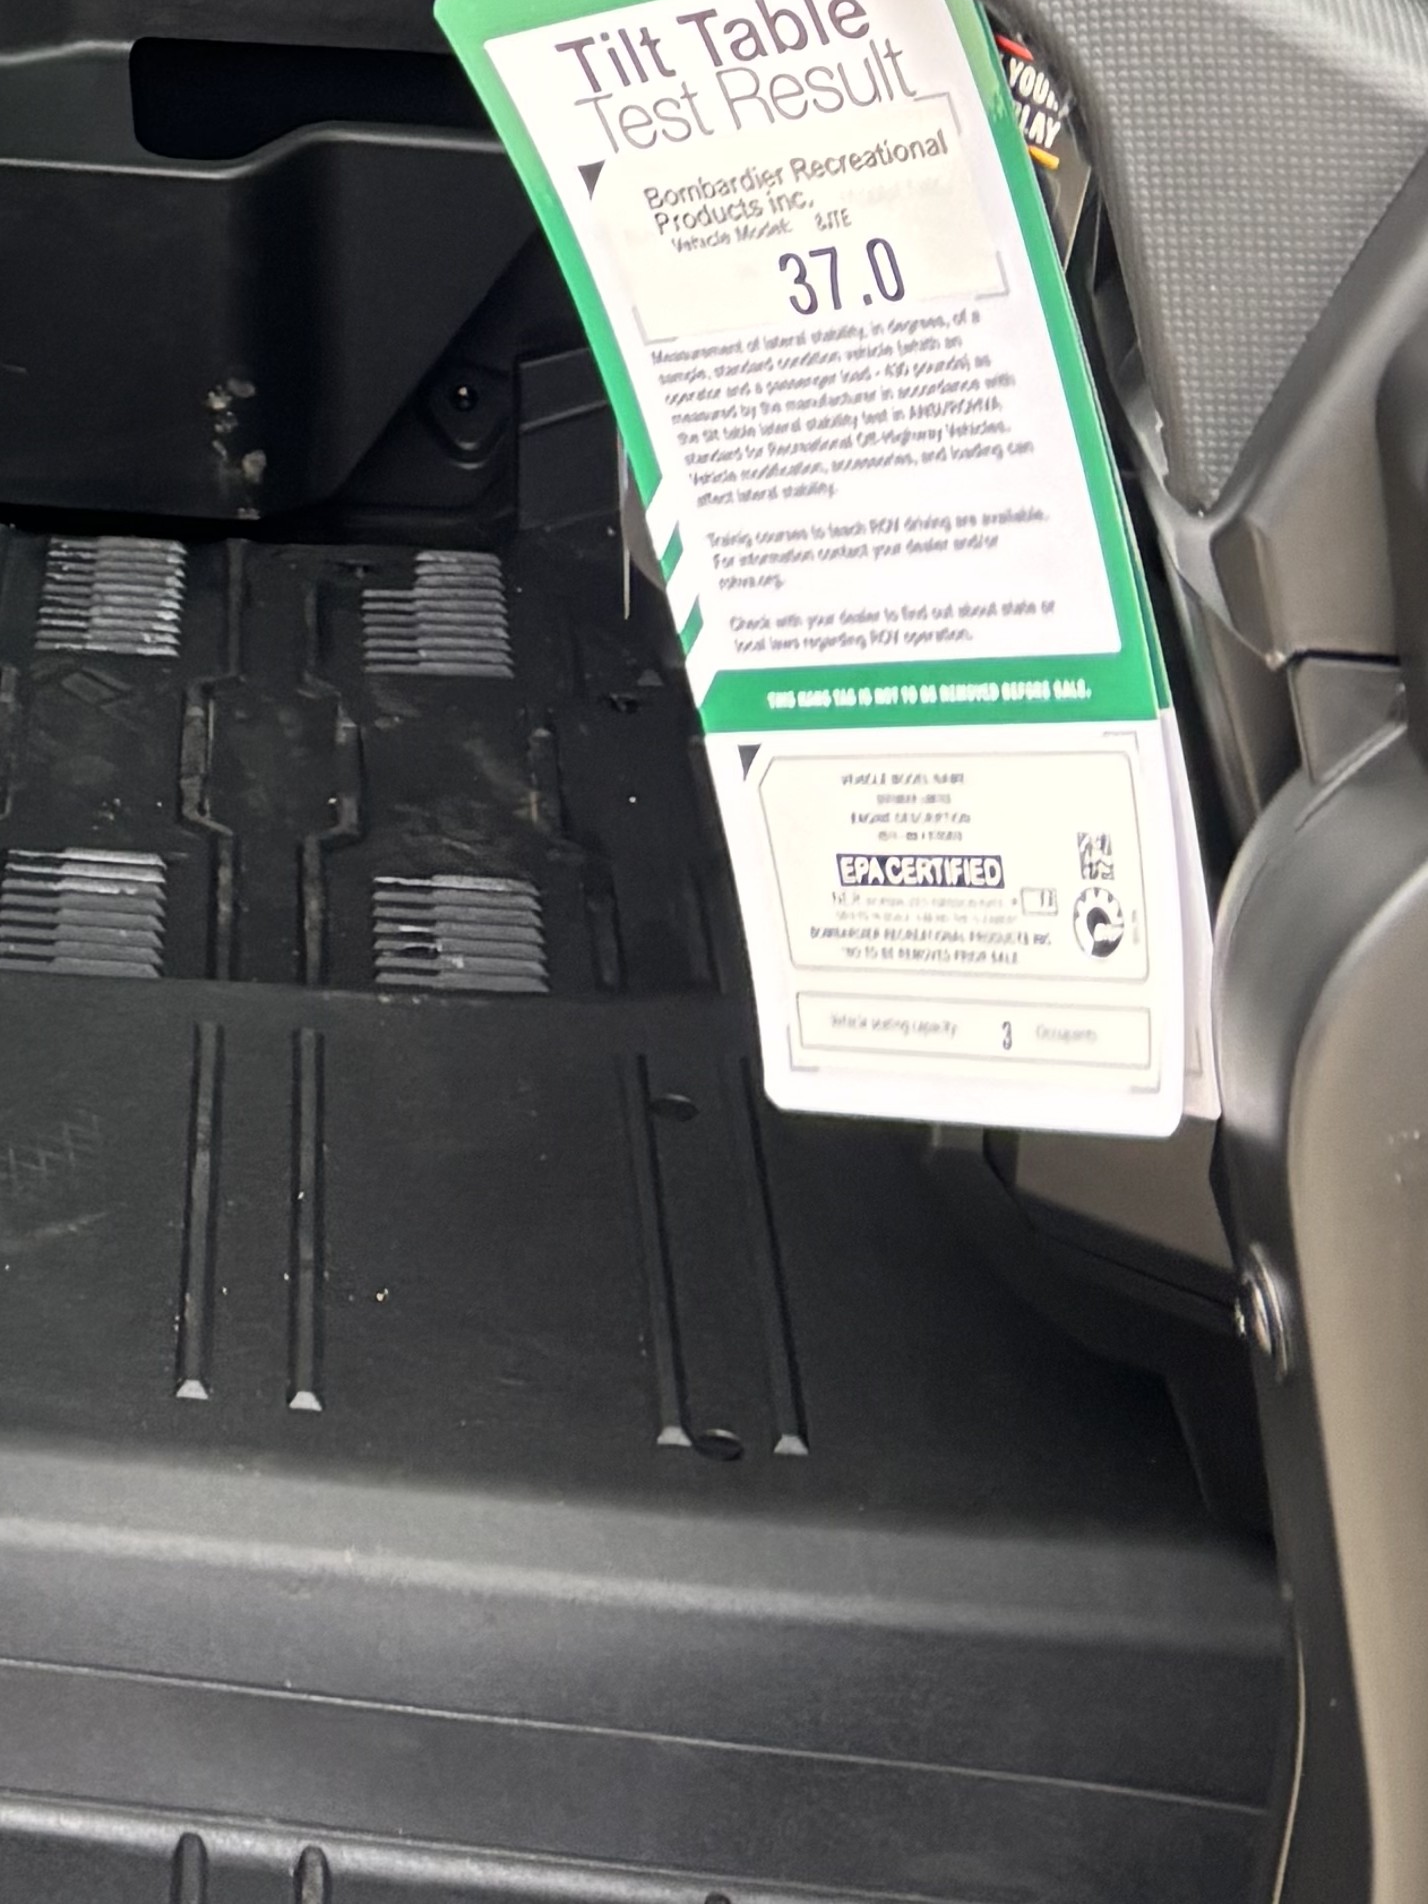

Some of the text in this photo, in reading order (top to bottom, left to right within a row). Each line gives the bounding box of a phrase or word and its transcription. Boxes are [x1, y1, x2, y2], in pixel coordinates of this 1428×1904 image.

[555, 27, 677, 93] Tilt
[575, 38, 917, 153] Test Result
[789, 129, 948, 184] Recreational
[654, 198, 764, 236] Products
[778, 237, 905, 315] 37.0
[840, 857, 1001, 885] EPA CERTIFIED
